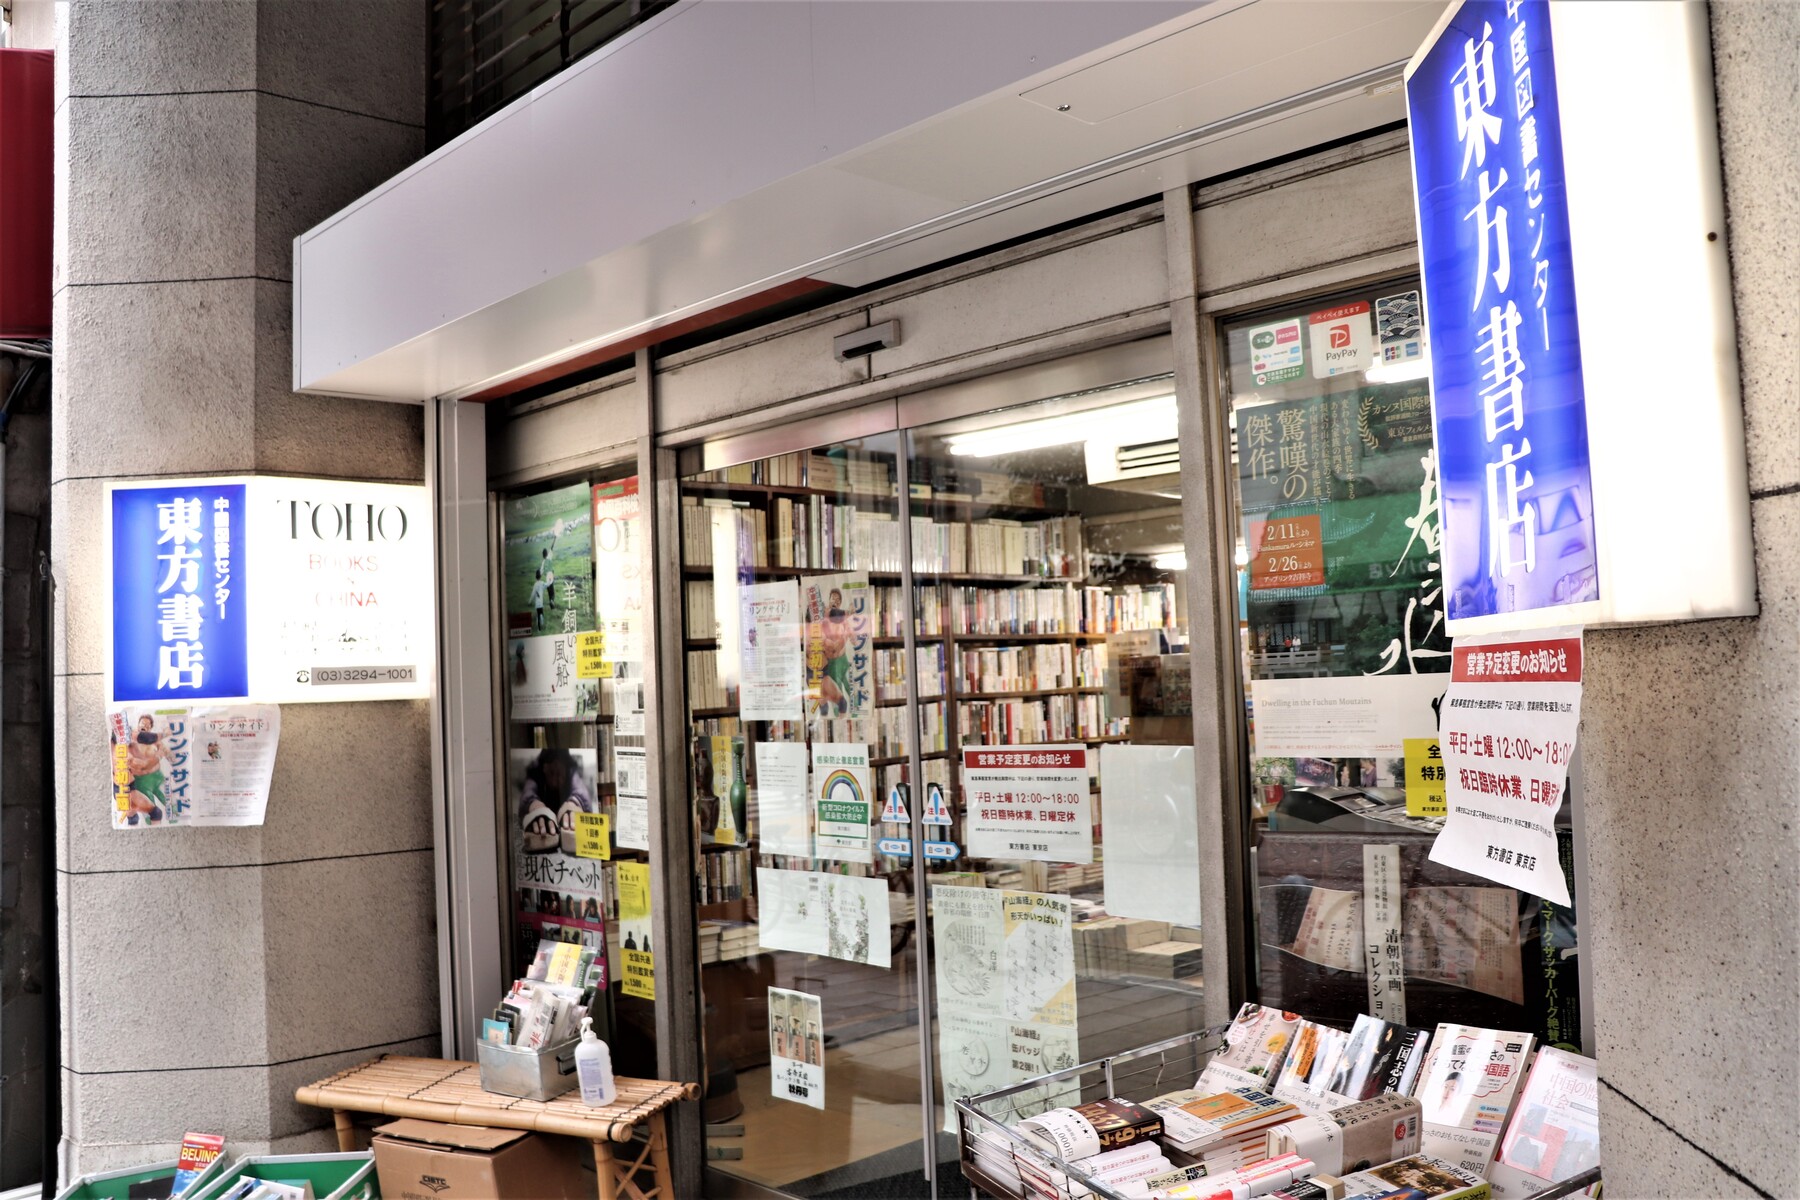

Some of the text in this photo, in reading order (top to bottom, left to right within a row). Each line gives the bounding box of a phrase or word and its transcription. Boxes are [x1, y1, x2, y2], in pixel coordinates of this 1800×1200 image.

[1450, 20, 1536, 578] 東方書店
[1325, 348, 1359, 361] PayPay
[1276, 408, 1310, 500] 驚嘆の
[276, 499, 408, 542] TOHO
[1268, 555, 1298, 572] 2/26
[157, 497, 205, 690] 東方書店
[553, 640, 570, 688] 風船
[852, 596, 870, 707] リングサイド
[1466, 647, 1568, 676] 営業予定変更のお知らせ
[1261, 698, 1292, 709] Dwelling
[168, 721, 191, 814] リングサイド
[977, 753, 1071, 766] 営業予定変更のお知らせ
[981, 808, 1076, 823] 祝日臨時休業、日曜定休
[524, 855, 600, 890] 現代チベット
[1486, 844, 1537, 872] 東方書店 東京店
[1385, 927, 1402, 992] 清朝書画
[1011, 1043, 1040, 1057] 缶バッジ
[180, 1147, 219, 1163] BEIJING
[1459, 1159, 1485, 1174] 620円
